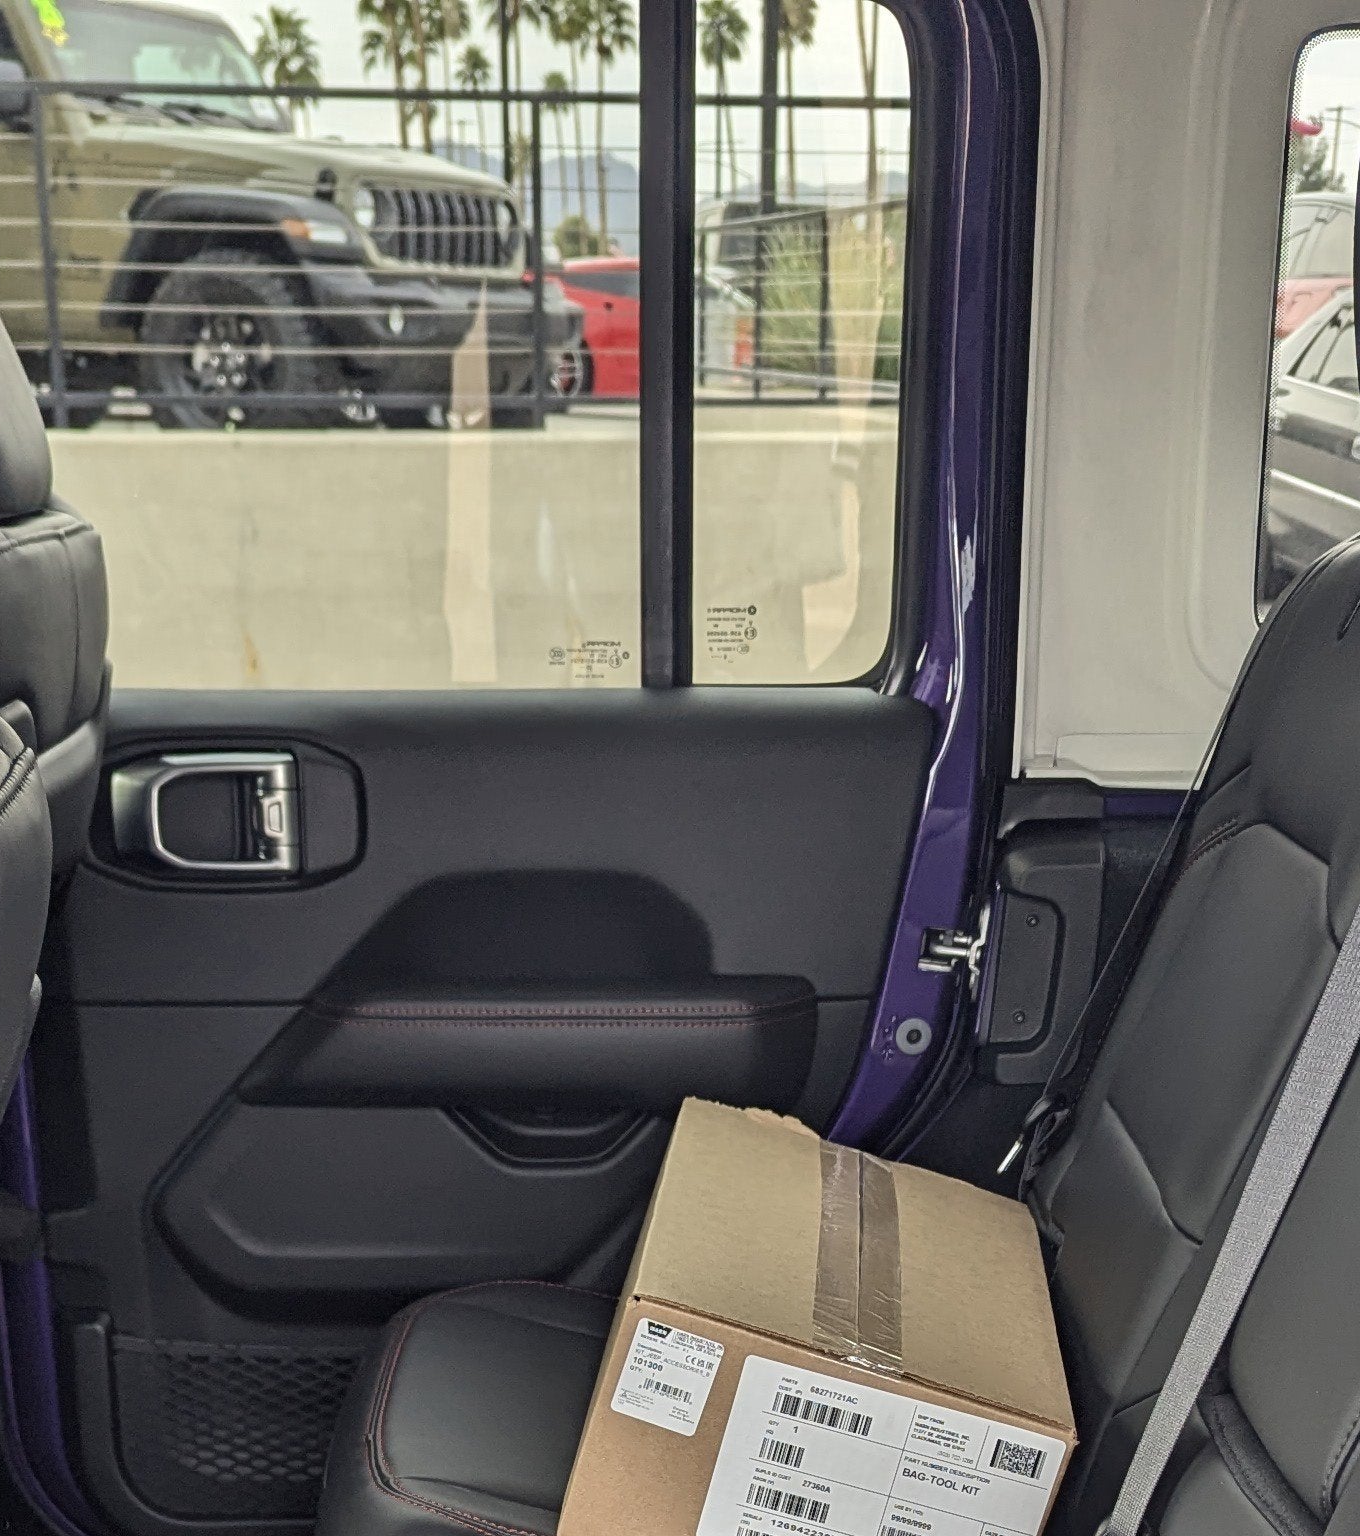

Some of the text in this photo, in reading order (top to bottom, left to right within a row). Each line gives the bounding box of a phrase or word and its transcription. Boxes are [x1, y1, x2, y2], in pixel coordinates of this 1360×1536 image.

[633, 1356, 663, 1372] 101300
[810, 1386, 859, 1405] 68271721AC
[902, 1467, 981, 1496] BAG-TOOL KIT
